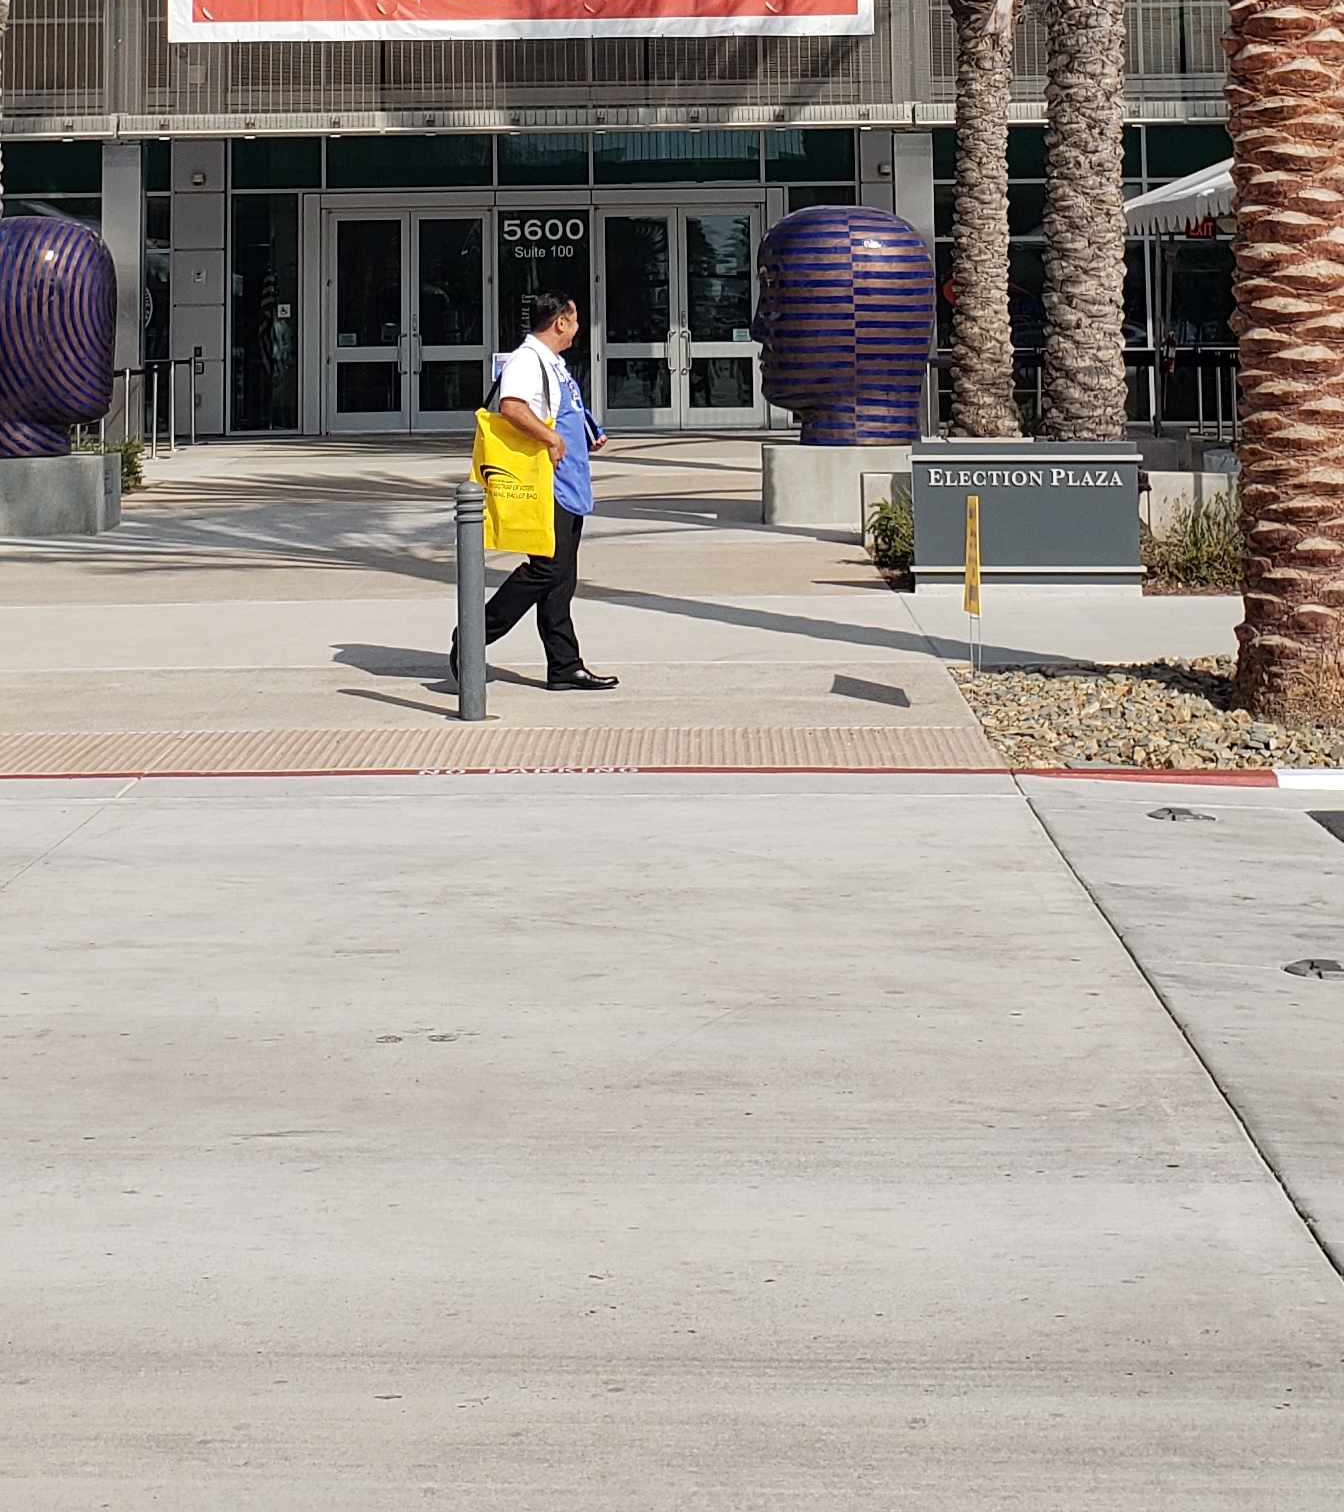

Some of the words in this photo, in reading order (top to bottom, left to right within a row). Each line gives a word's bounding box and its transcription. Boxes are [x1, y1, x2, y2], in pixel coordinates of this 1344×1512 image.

[503, 219, 584, 241] 5600
[514, 246, 546, 258] Suite
[550, 245, 574, 258] 100
